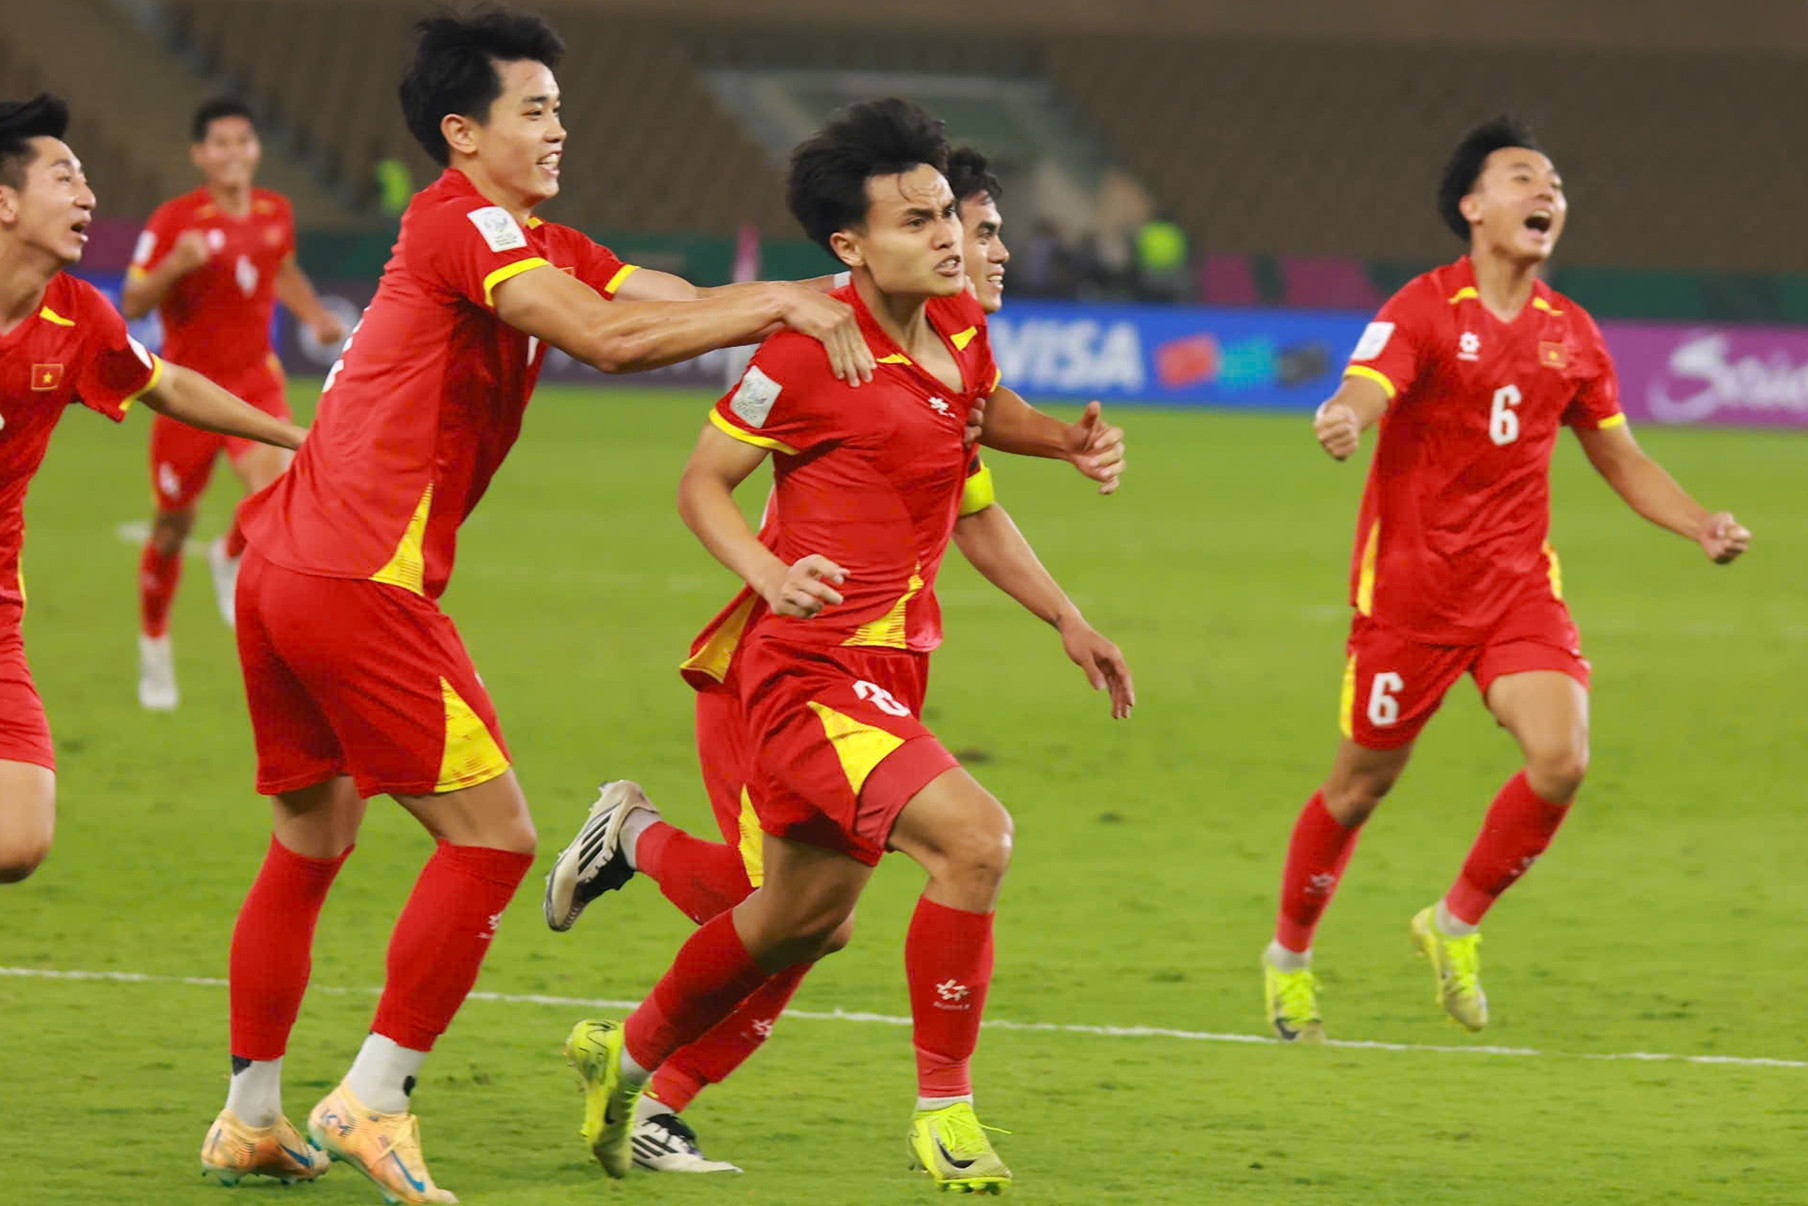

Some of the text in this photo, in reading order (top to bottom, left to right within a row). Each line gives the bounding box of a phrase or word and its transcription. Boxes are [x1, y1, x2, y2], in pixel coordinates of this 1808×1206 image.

[988, 317, 1146, 392] VISA
[1489, 383, 1522, 446] 6
[1366, 671, 1404, 727] 6
